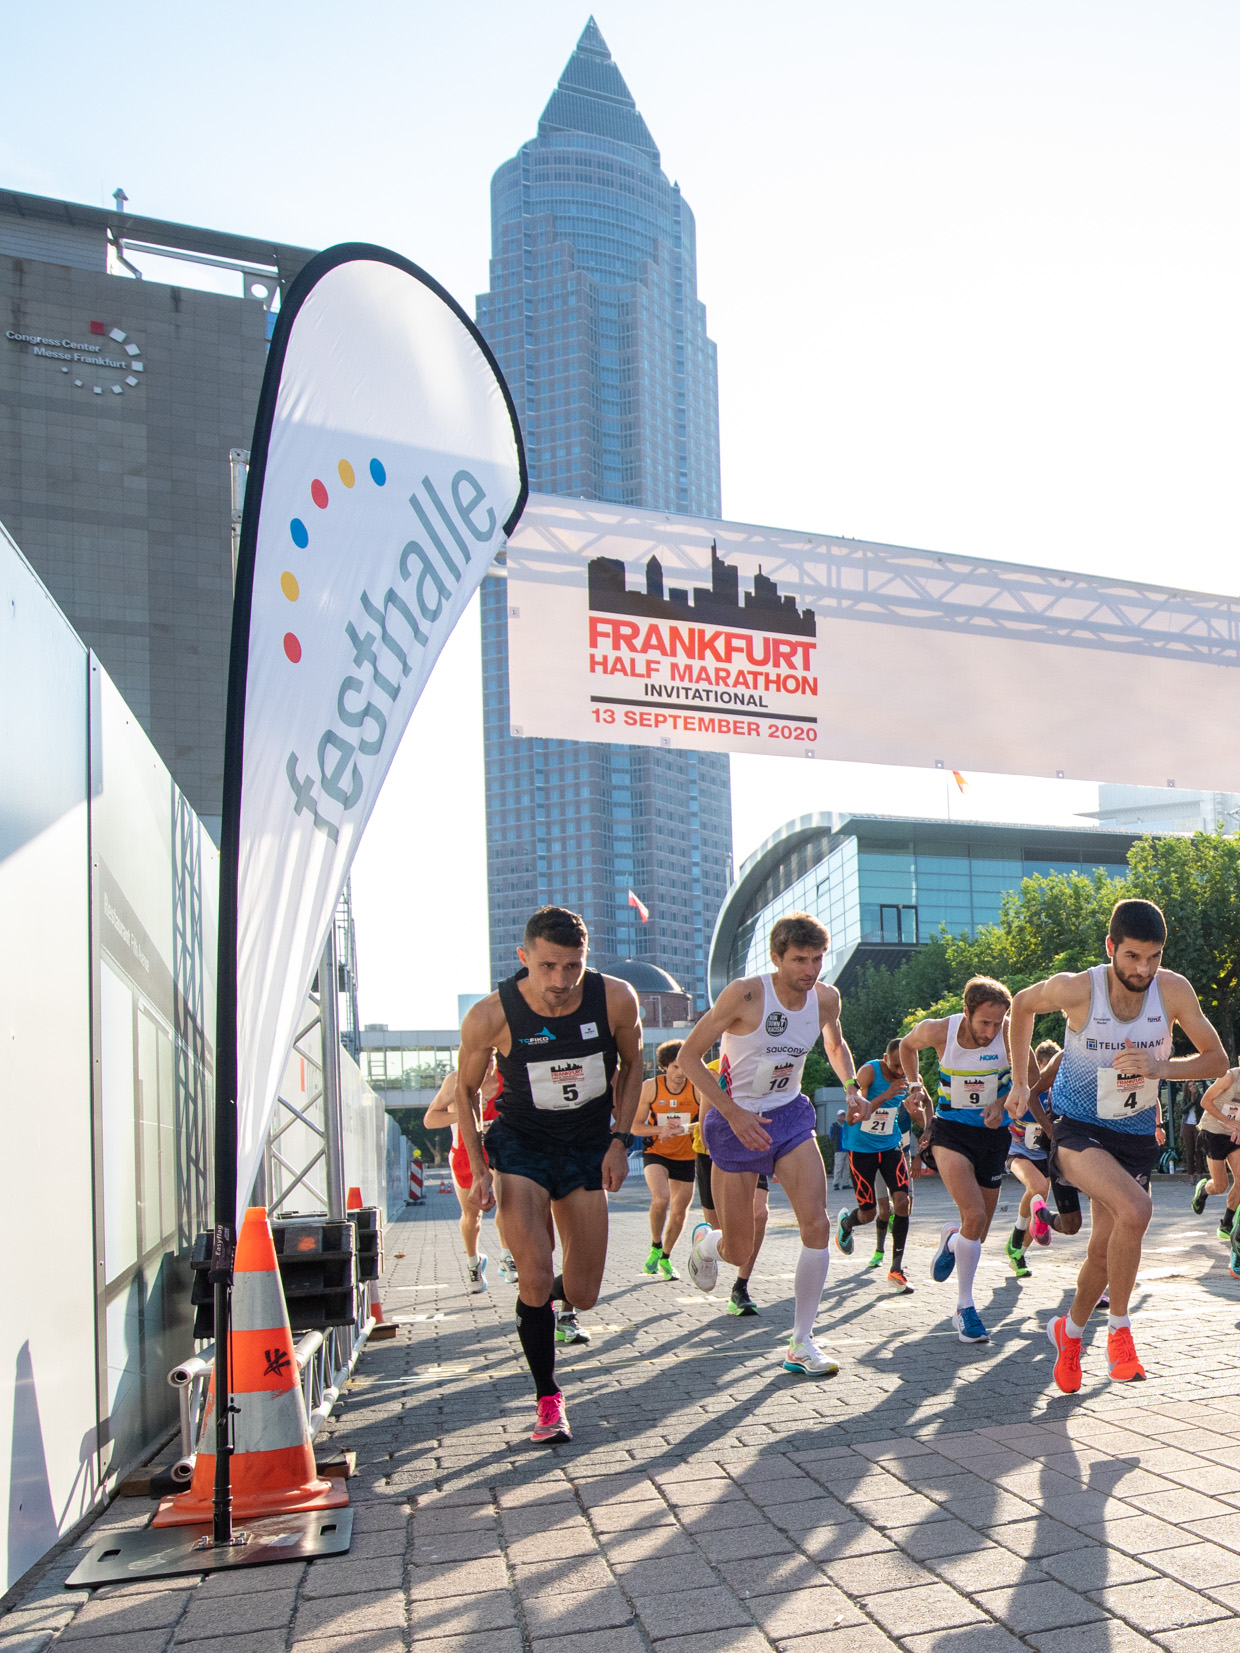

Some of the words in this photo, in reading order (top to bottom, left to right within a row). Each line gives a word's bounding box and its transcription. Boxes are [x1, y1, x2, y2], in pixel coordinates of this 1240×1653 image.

[6, 330, 61, 346] Congress
[61, 339, 101, 352] Center
[33, 346, 72, 360] Messe
[73, 353, 126, 369] Frankfurt
[588, 616, 817, 671] FRANKFURT
[286, 469, 497, 845] festhalle
[589, 653, 661, 678] HALF
[670, 662, 818, 696] MARATHON
[644, 683, 768, 708] INVITATIONAL
[591, 708, 616, 724] 13
[623, 710, 761, 737] SEPTEMBER
[768, 724, 818, 742] 2020
[766, 1046, 805, 1054] saucony
[1099, 1042, 1126, 1051] TELIS
[562, 1084, 579, 1102] 5
[769, 1078, 790, 1092] 10
[969, 1092, 980, 1105] 9
[1124, 1092, 1138, 1109] 4
[871, 1120, 886, 1132] 21
[215, 1224, 224, 1256] Easyflag
